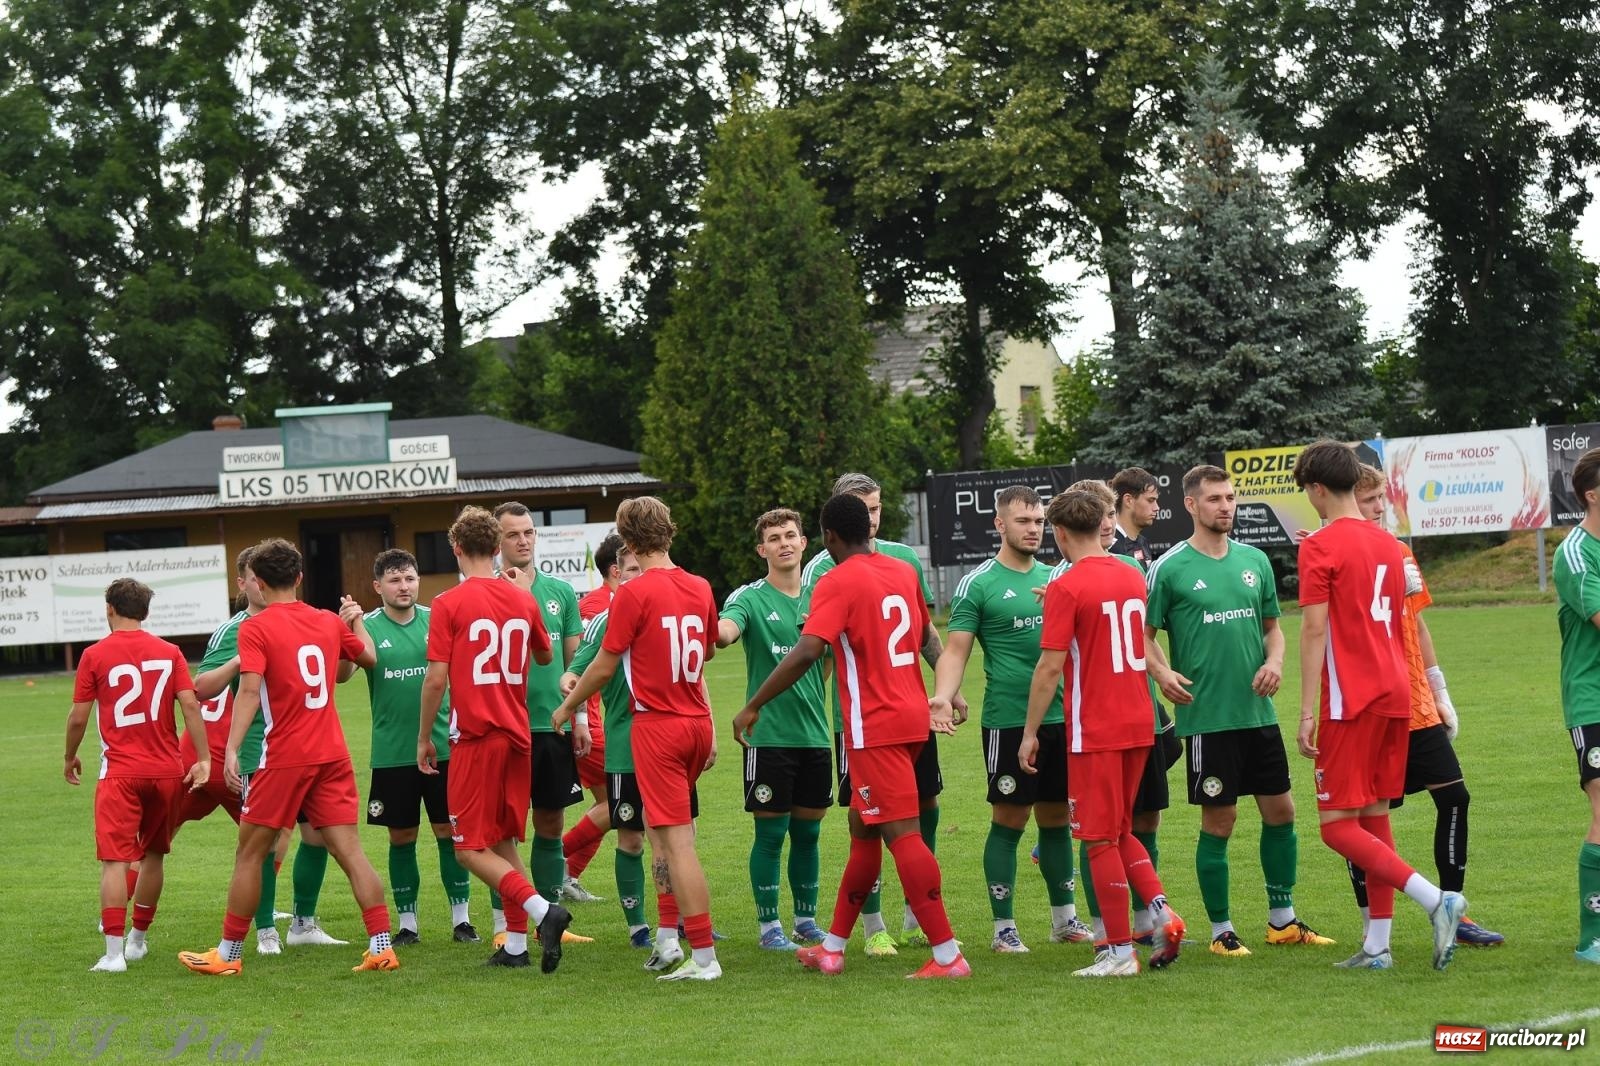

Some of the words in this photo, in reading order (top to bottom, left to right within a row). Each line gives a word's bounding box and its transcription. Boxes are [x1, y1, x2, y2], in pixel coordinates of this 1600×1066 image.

[401, 442, 438, 455] GOŚCIE
[1552, 432, 1591, 451] safer
[228, 451, 281, 464] TWORKÓW
[1231, 453, 1297, 474] ODZIE
[1424, 451, 1453, 462] Firma
[226, 477, 272, 499] LKS
[283, 475, 309, 495] 05
[318, 463, 450, 493] TWORKÓW
[1234, 478, 1243, 487] Z
[1245, 475, 1294, 487] HAFTEM
[1446, 480, 1504, 496] LEWIATAN
[1239, 487, 1295, 497] NADRUKIEM
[1421, 517, 1437, 529] tel:
[1439, 513, 1503, 527] 507-144-696
[1557, 511, 1586, 520] WIZUALIZ
[57, 562, 123, 578] Schlesisches
[126, 555, 220, 574] Malerhandwerk
[540, 558, 595, 574] OKNA
[1369, 564, 1392, 639] 4
[881, 594, 915, 668] 2
[1102, 599, 1146, 674] 10
[469, 618, 530, 685] 20
[661, 614, 704, 684] 16
[297, 645, 328, 710] 9
[108, 659, 173, 728] 27
